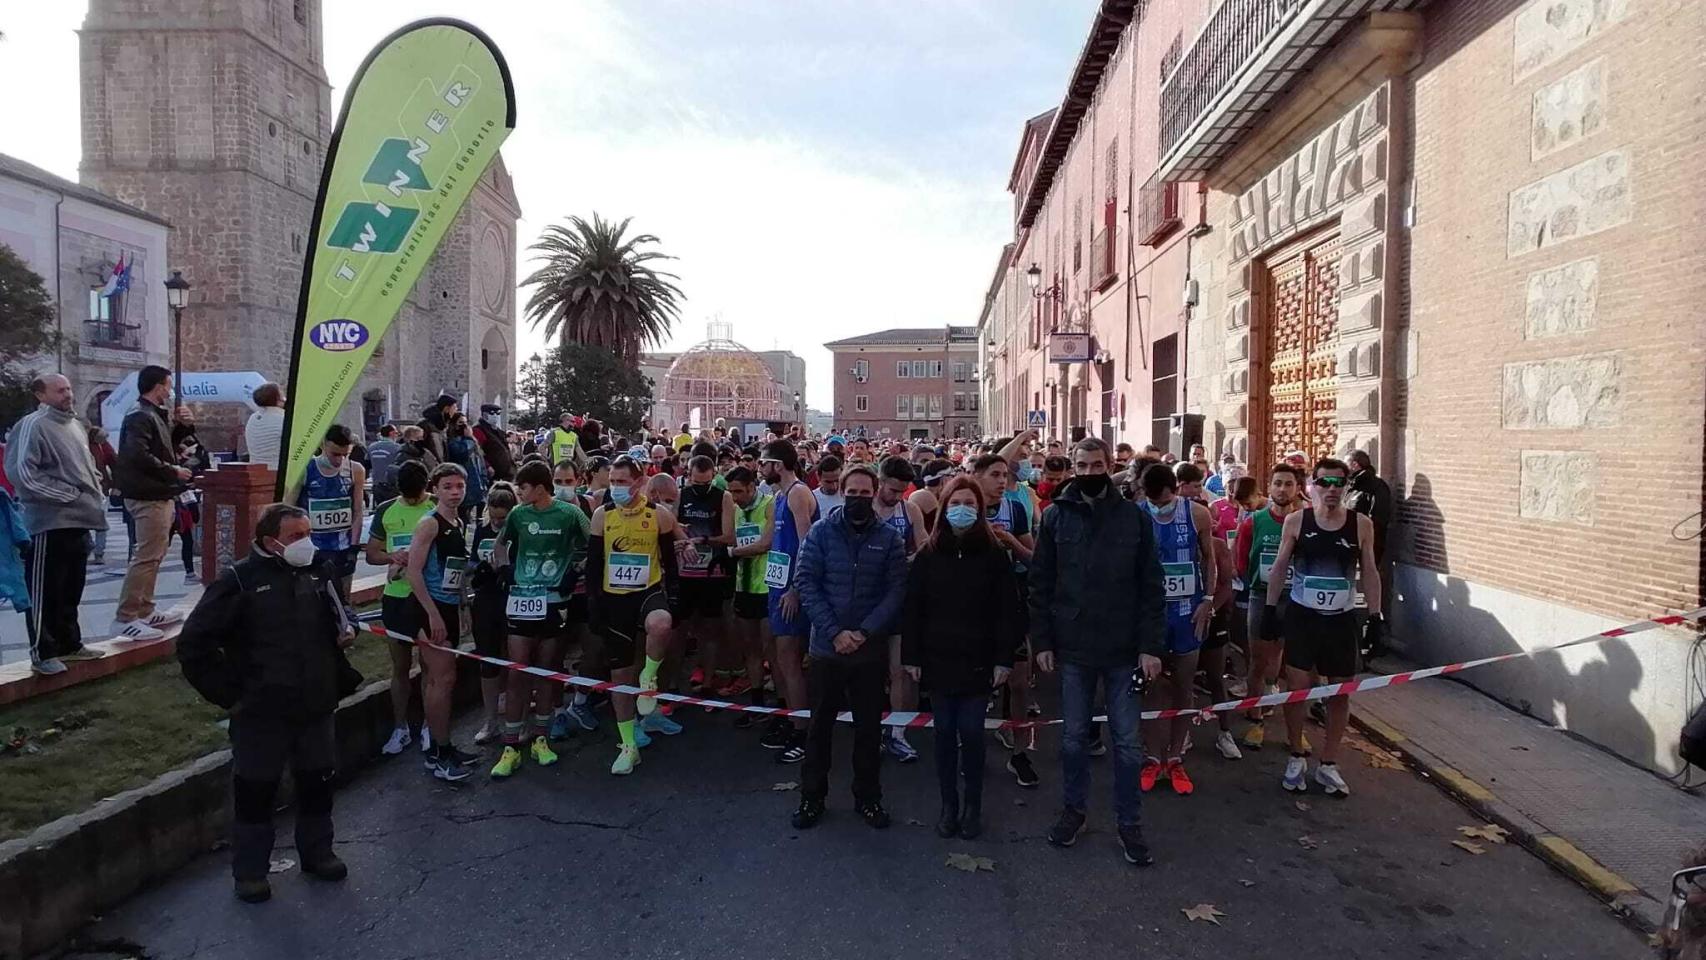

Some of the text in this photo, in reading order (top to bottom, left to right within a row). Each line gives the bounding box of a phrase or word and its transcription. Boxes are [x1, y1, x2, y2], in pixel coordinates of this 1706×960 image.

[336, 80, 472, 281] TWINNER
[381, 119, 495, 296] especialistas del deporte
[319, 322, 360, 343] NYC
[181, 381, 218, 397] ualia
[292, 360, 353, 461] www.ventadeporte.com
[315, 511, 349, 526] 1502
[615, 567, 642, 581] 447
[766, 564, 784, 580] 283
[513, 599, 543, 613] 1509
[1316, 591, 1337, 606] 97
